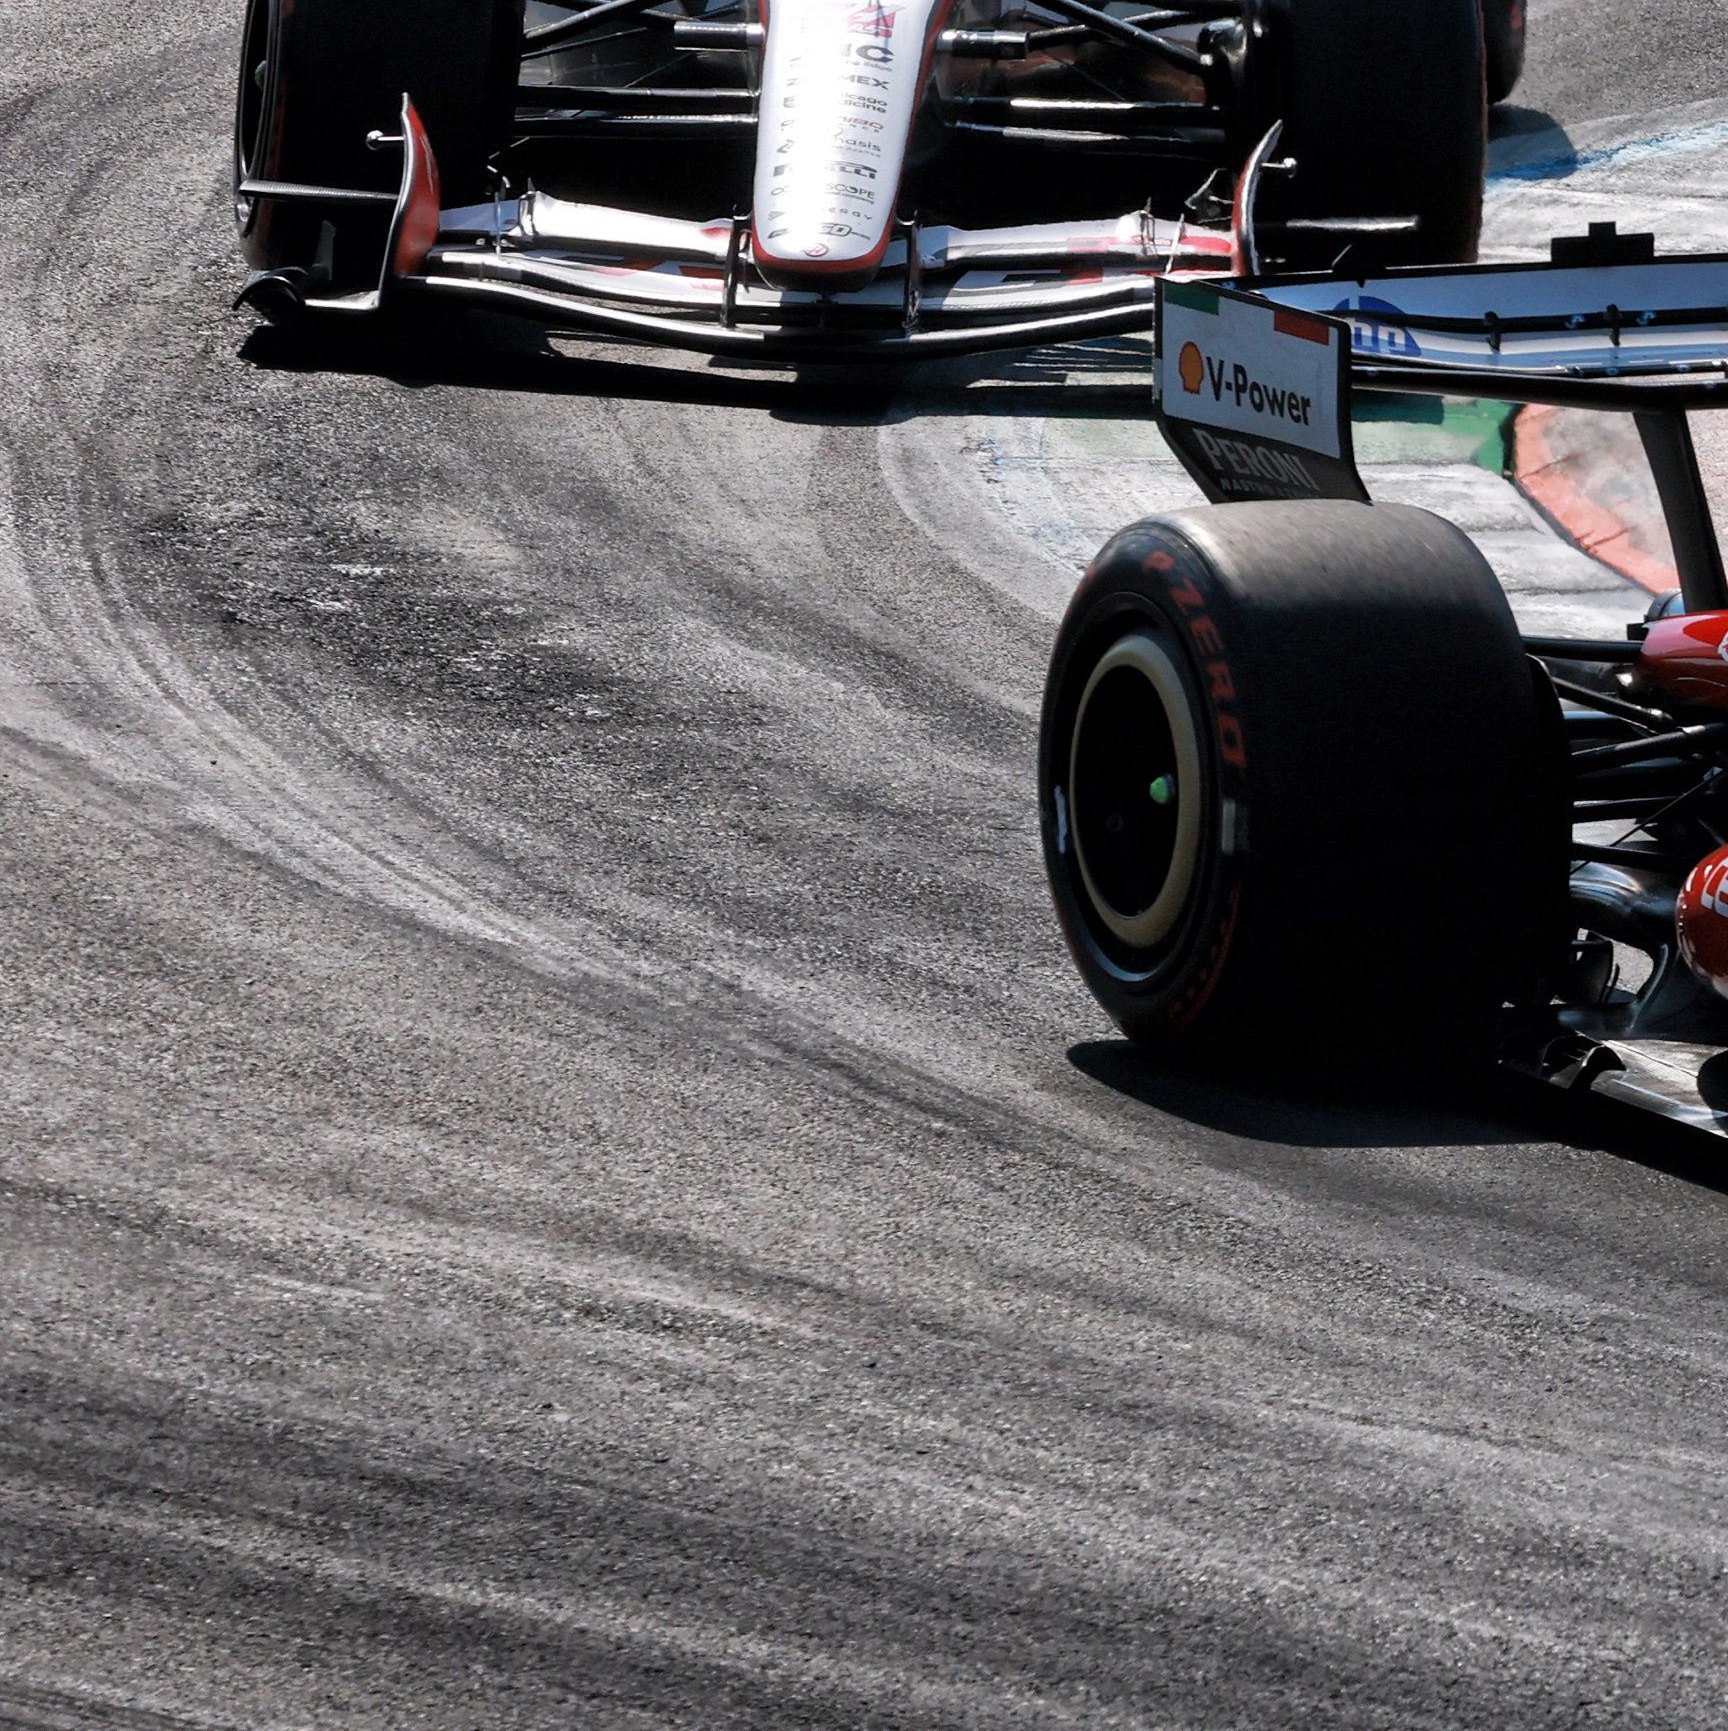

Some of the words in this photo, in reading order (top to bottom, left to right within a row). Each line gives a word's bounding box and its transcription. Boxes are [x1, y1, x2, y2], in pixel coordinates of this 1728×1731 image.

[1204, 355, 1313, 427] V-Power
[1191, 427, 1321, 492] PERONI
[1168, 577, 1249, 769] ZERO
